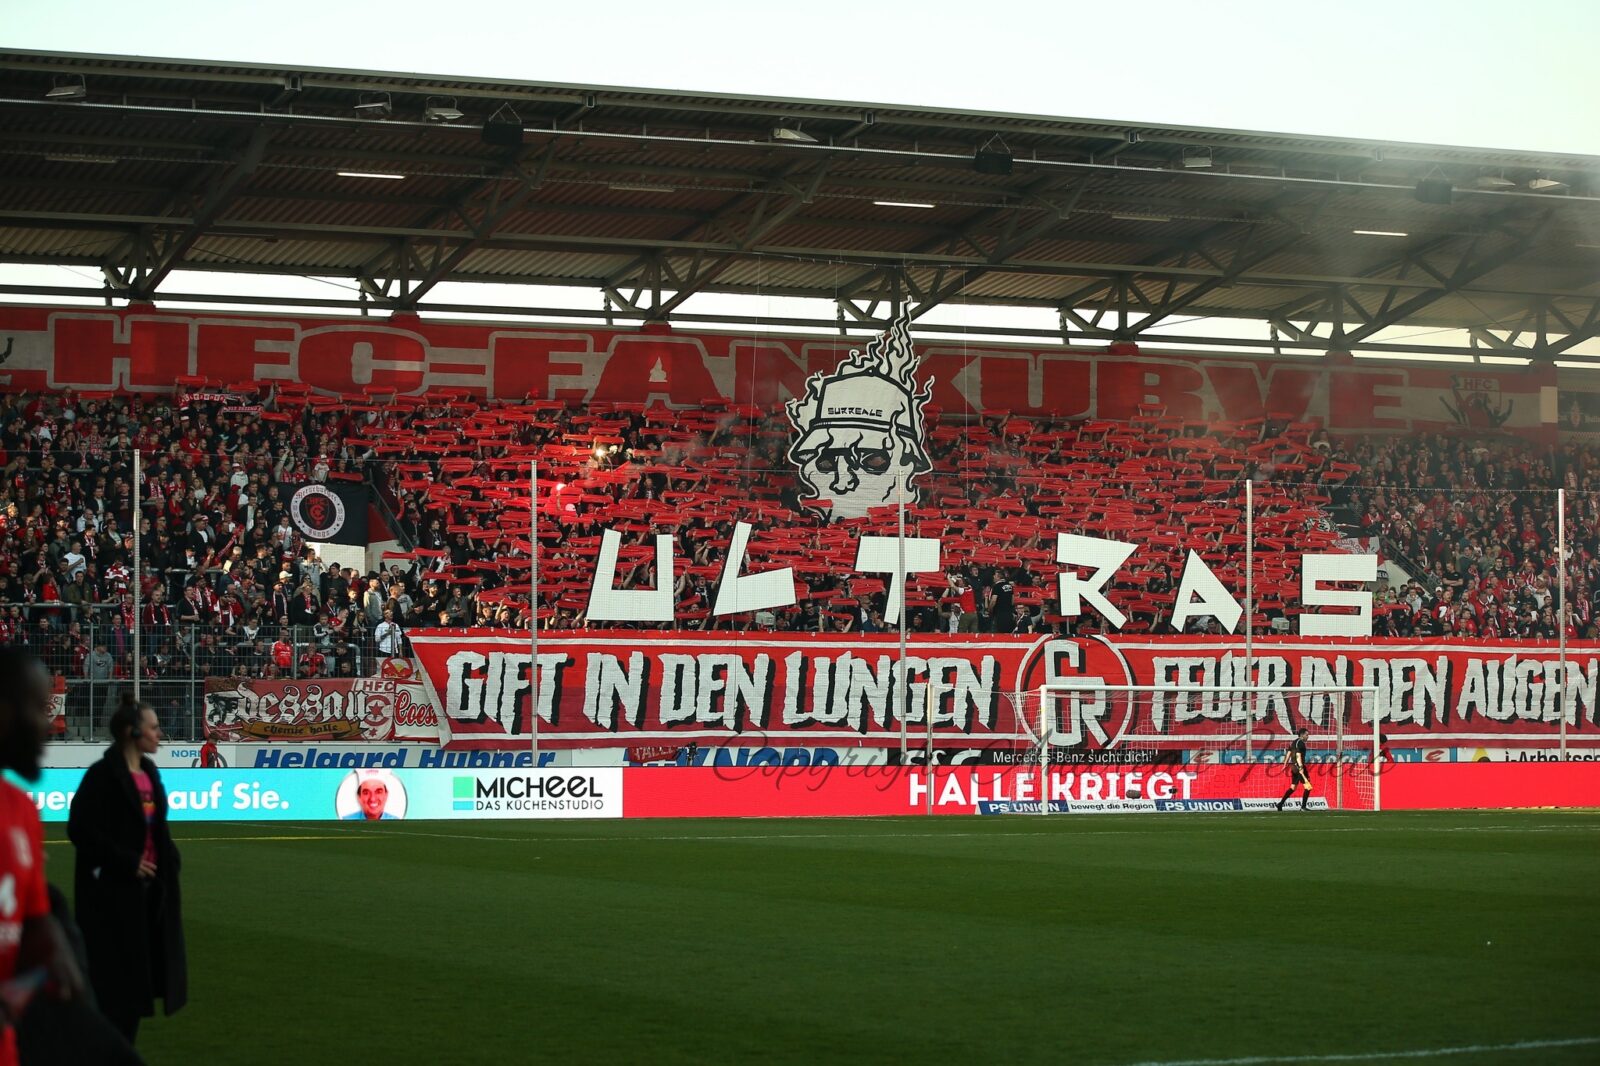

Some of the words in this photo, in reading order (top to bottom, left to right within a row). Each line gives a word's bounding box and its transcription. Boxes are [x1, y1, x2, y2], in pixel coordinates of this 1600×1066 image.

[827, 407, 883, 417] SURREALE
[362, 680, 395, 692] HFC
[446, 650, 573, 735] GIFT
[583, 650, 649, 732] IN
[658, 653, 774, 734] DEN
[783, 650, 998, 734] LUNGEN
[1152, 650, 1294, 735] FEUER
[1299, 654, 1353, 730] IN
[1358, 655, 1452, 730] DEN
[1456, 653, 1600, 730] AUGEN
[171, 750, 201, 758] NOR
[993, 752, 1085, 763] Mercedes-Benz
[1088, 752, 1122, 763] sucht
[1124, 751, 1152, 763] dich!
[909, 772, 1035, 806] HALLE
[1052, 771, 1198, 801] KRIEGT
[167, 780, 223, 810] auf
[233, 782, 290, 810] Sie.
[476, 801, 501, 811] DAS
[507, 799, 604, 811] KÜCHENSTUDIO
[989, 803, 1008, 813] PS
[1071, 803, 1106, 812] bewegt
[1107, 802, 1121, 811] die
[1122, 802, 1155, 811] Region
[1164, 802, 1186, 811] PS
[1188, 801, 1235, 811] UNION
[1296, 800, 1326, 808] Rgion
